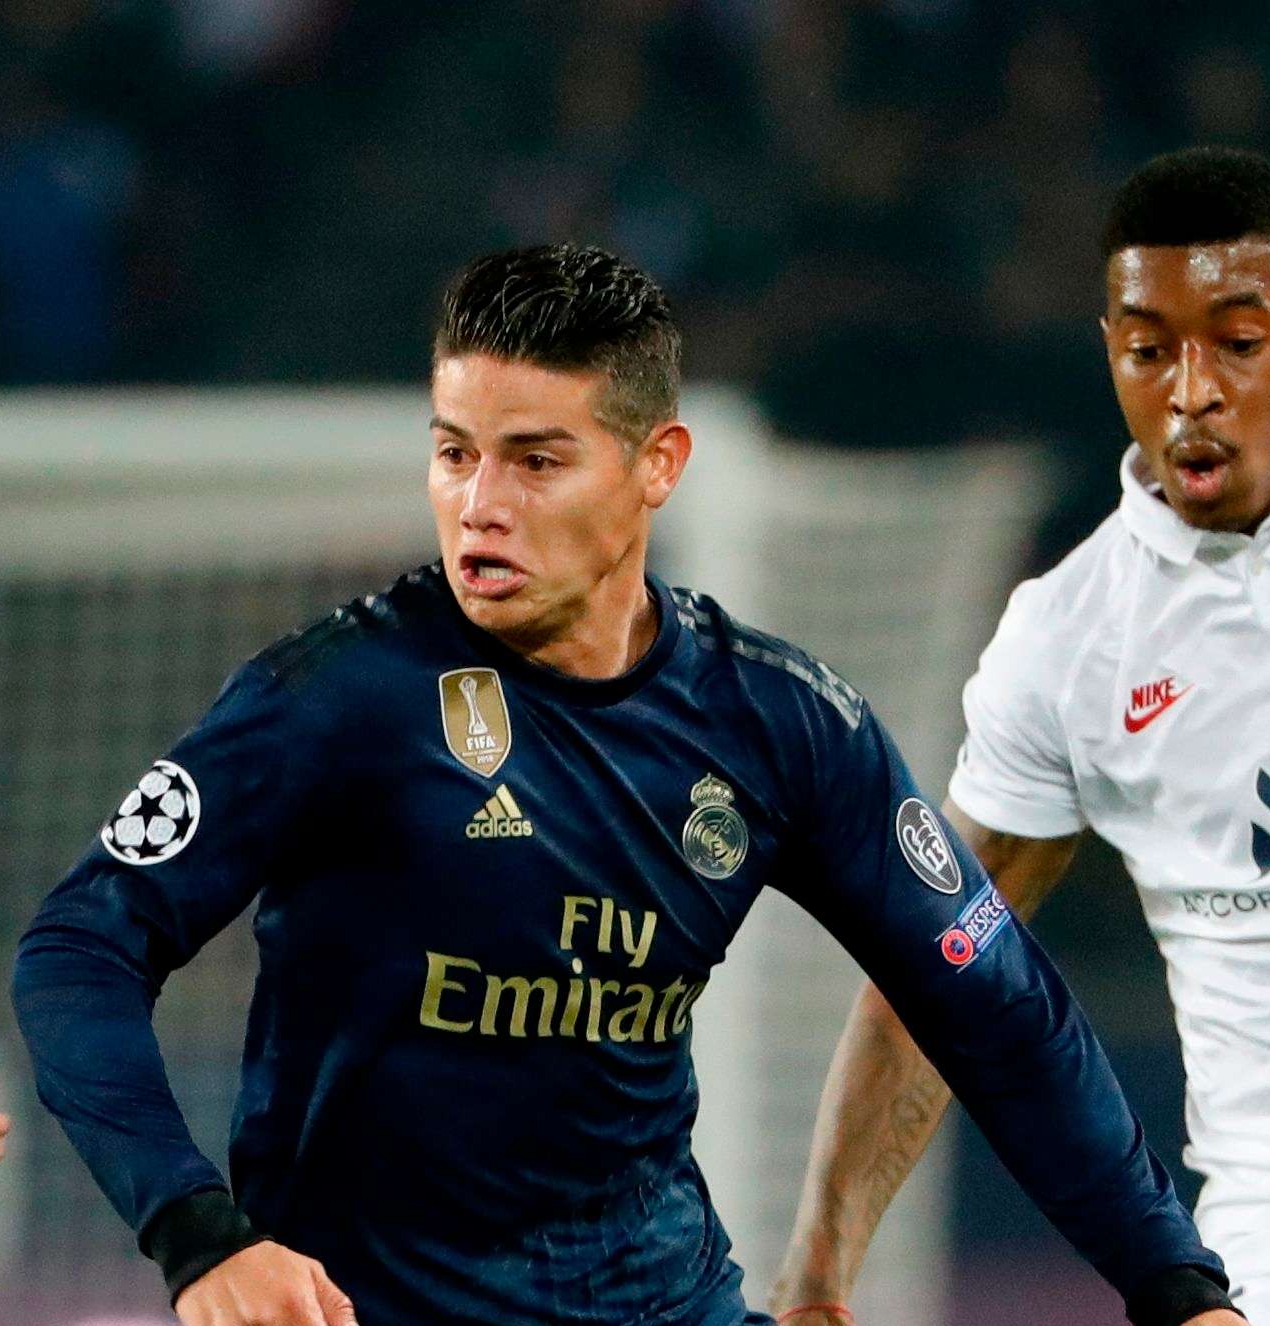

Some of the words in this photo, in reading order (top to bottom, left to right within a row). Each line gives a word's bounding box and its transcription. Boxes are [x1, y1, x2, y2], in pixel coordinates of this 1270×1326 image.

[1131, 677, 1176, 711] NIKE
[466, 735, 496, 750] FIFA
[465, 816, 534, 839] adidas
[560, 895, 658, 968] Fly
[964, 889, 1006, 943] RESPEC
[419, 950, 704, 1043] Emirate
